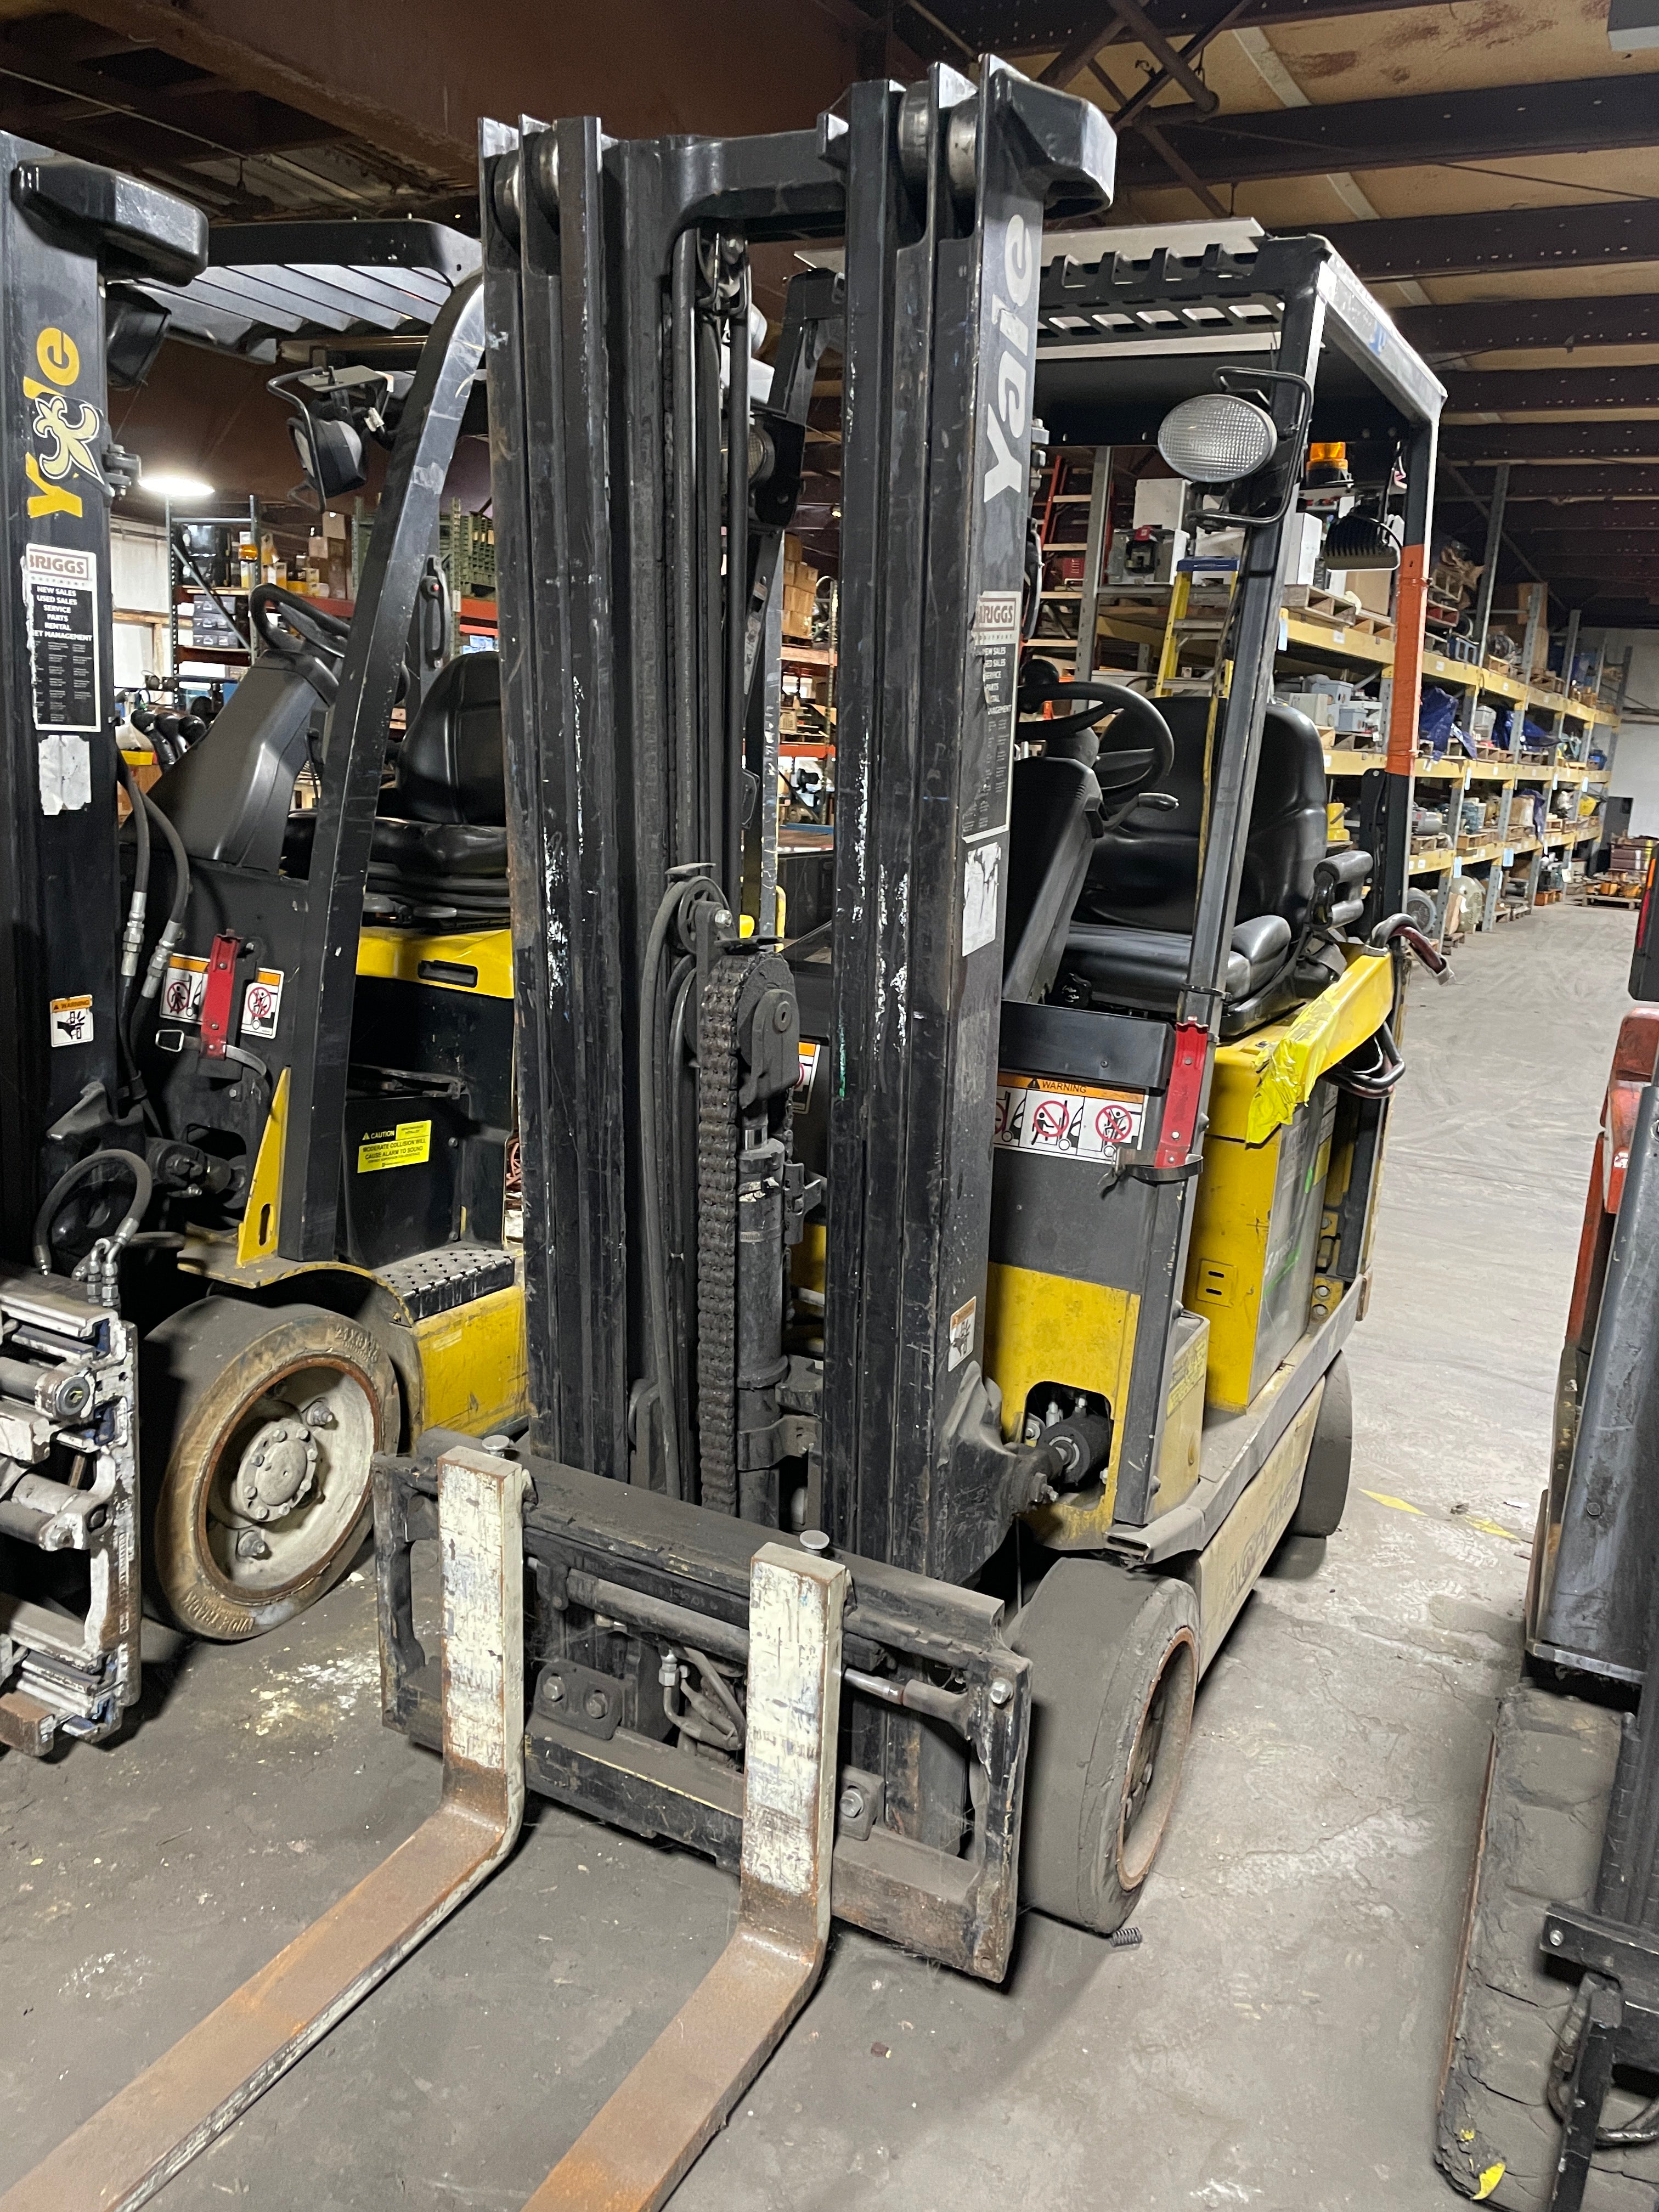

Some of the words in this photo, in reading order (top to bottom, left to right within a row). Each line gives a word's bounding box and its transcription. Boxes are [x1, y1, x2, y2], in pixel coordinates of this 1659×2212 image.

[984, 214, 1032, 503] Yale
[37, 585, 54, 594] NEW
[55, 588, 76, 597] SALES
[37, 595, 55, 603] USED
[56, 597, 77, 606] SALES
[43, 604, 71, 613] SERVICE
[47, 613, 69, 622] PARTS
[44, 622, 71, 631] RENTAL
[44, 631, 93, 641] MANAGEMENT
[1042, 1080, 1087, 1094] WARNING
[370, 1130, 395, 1139] CAUTION
[363, 1143, 389, 1153] MODERATE
[390, 1140, 414, 1149] COLLISION
